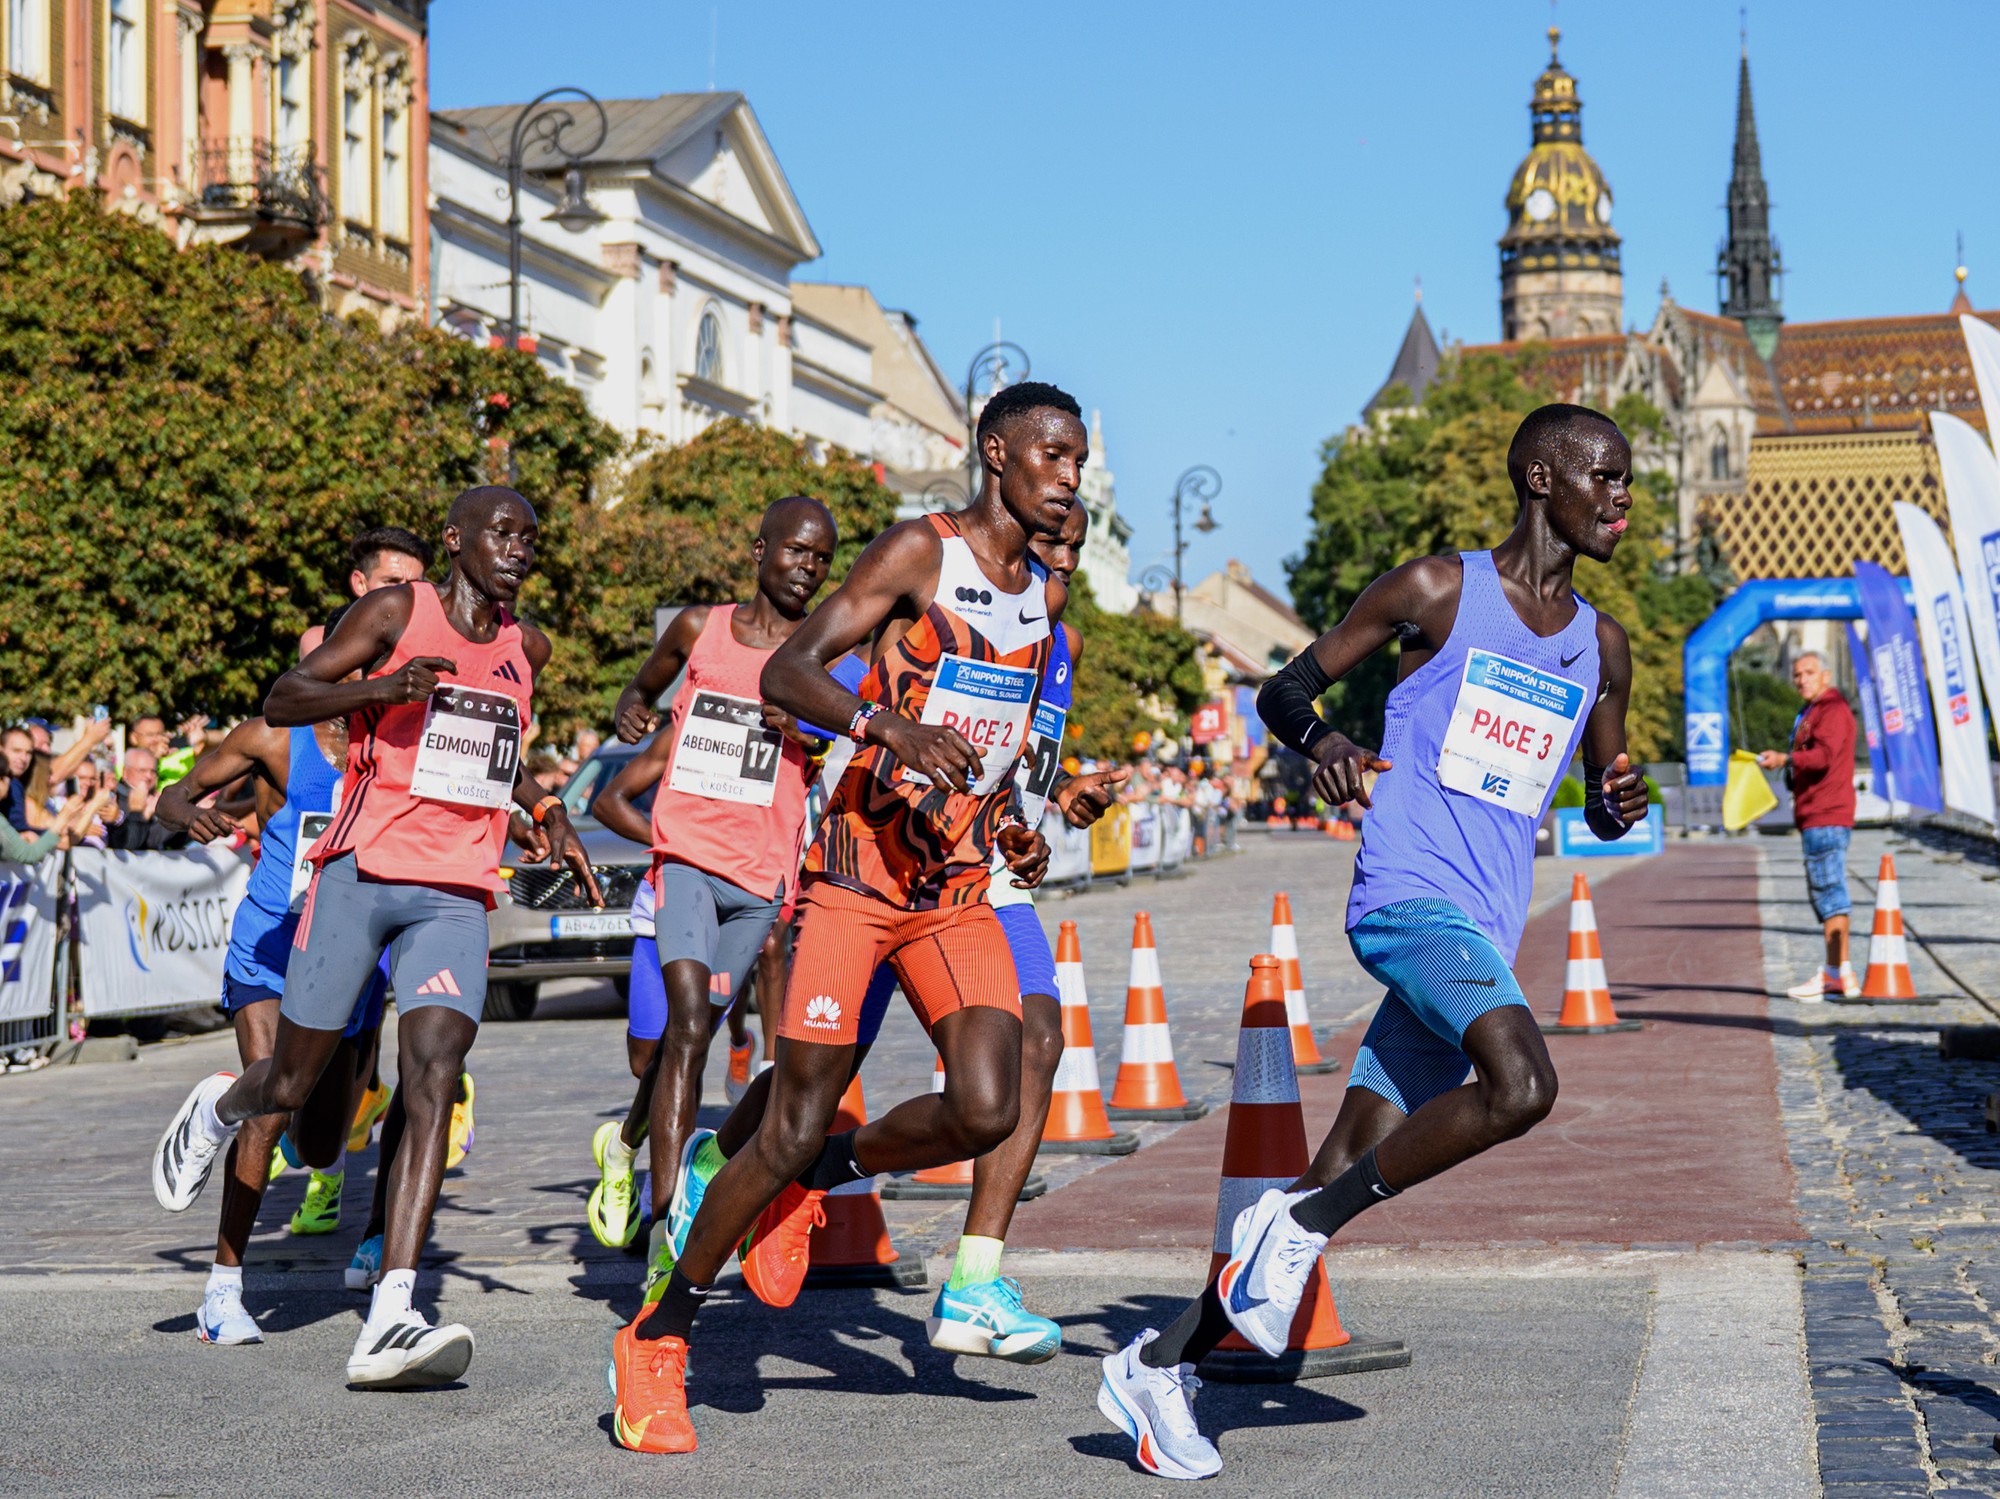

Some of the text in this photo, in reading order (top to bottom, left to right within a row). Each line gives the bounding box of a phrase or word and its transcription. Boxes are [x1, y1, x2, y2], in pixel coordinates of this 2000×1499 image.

[953, 682, 979, 692] NIPPON
[980, 687, 997, 697] STEEL
[971, 670, 1024, 687] NIPPON STEEL
[1501, 666, 1568, 698] NIPPON STEEL
[444, 696, 514, 717] VOLVO
[1484, 677, 1564, 712] NIPPON STEEL SLOVAKIA
[703, 702, 761, 720] VOLV
[1040, 710, 1056, 723] STEEL
[1001, 721, 1013, 748] 2
[1470, 708, 1553, 760] PACE 3
[426, 733, 514, 770] EDMOND 11
[683, 734, 775, 770] ABEDNEGO 17
[1039, 751, 1050, 781] 1
[457, 785, 491, 799] KOŠICE
[710, 782, 744, 796] KOŠICE
[152, 887, 229, 952] KOŠICE
[803, 1018, 841, 1030] HUAWEI
